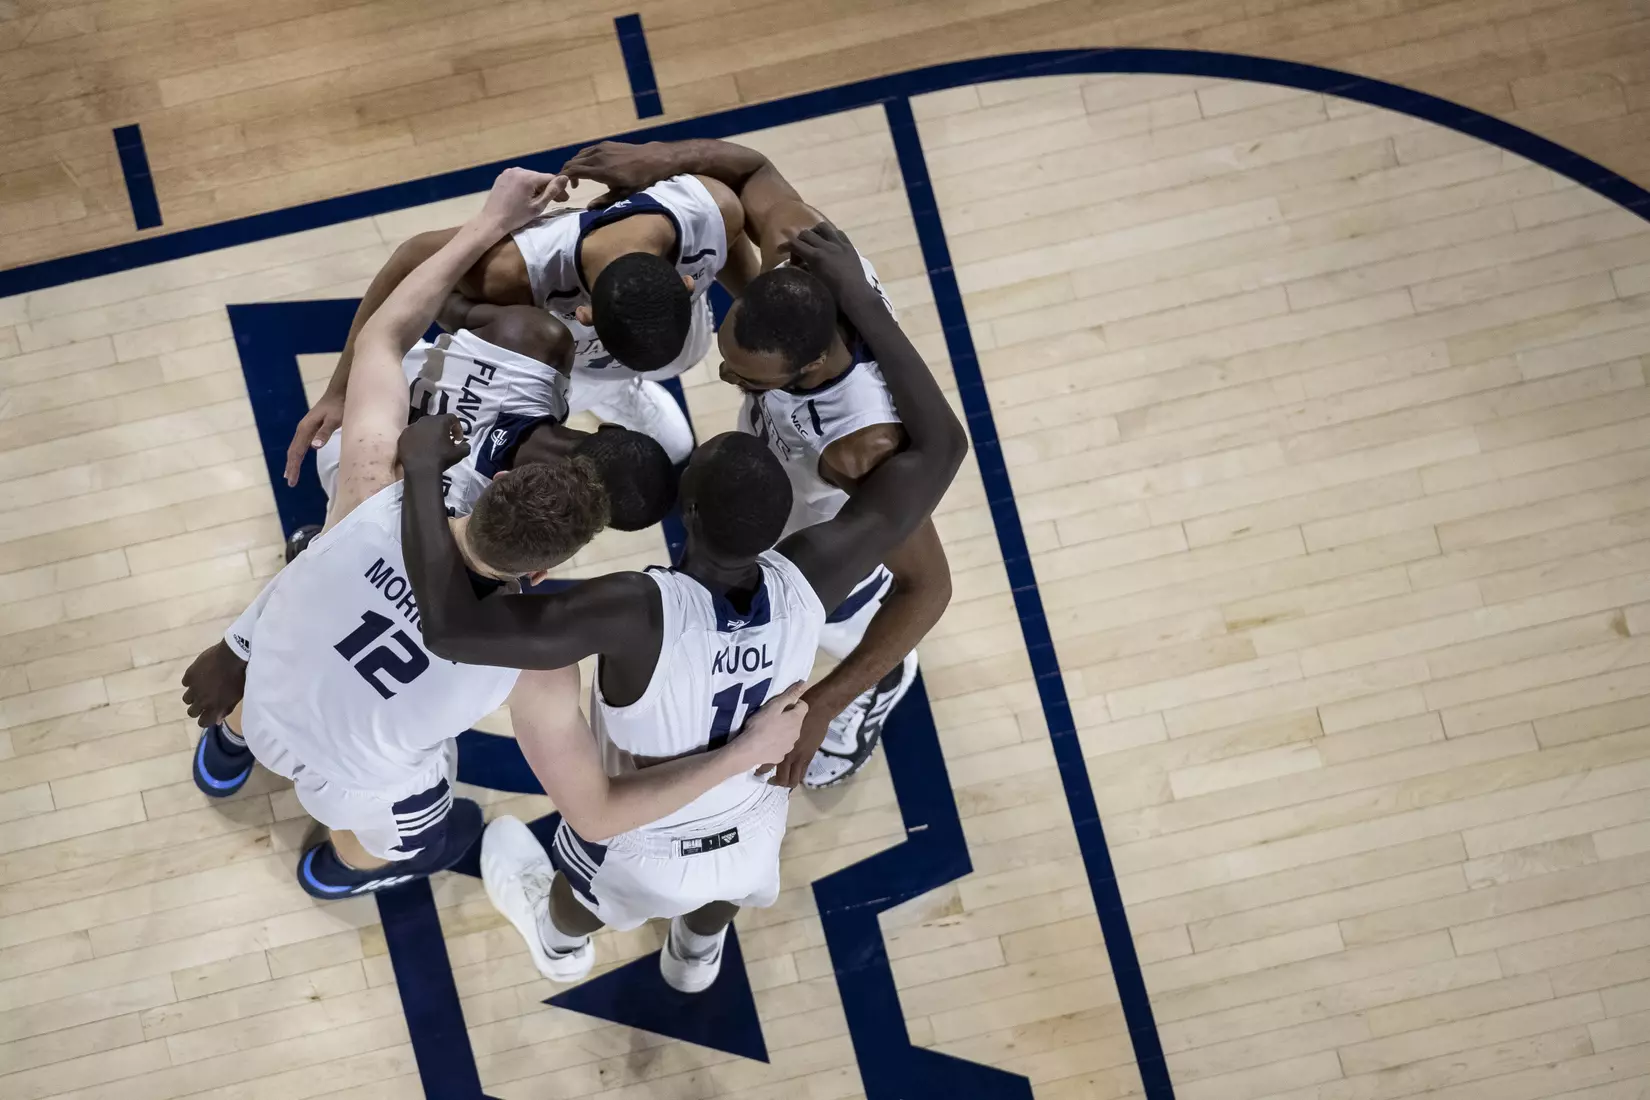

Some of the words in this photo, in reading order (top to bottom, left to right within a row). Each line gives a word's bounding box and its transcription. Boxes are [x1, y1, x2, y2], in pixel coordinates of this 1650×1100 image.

[333, 610, 430, 700] 12
[711, 643, 774, 676] KUOL
[707, 677, 773, 753] 11
